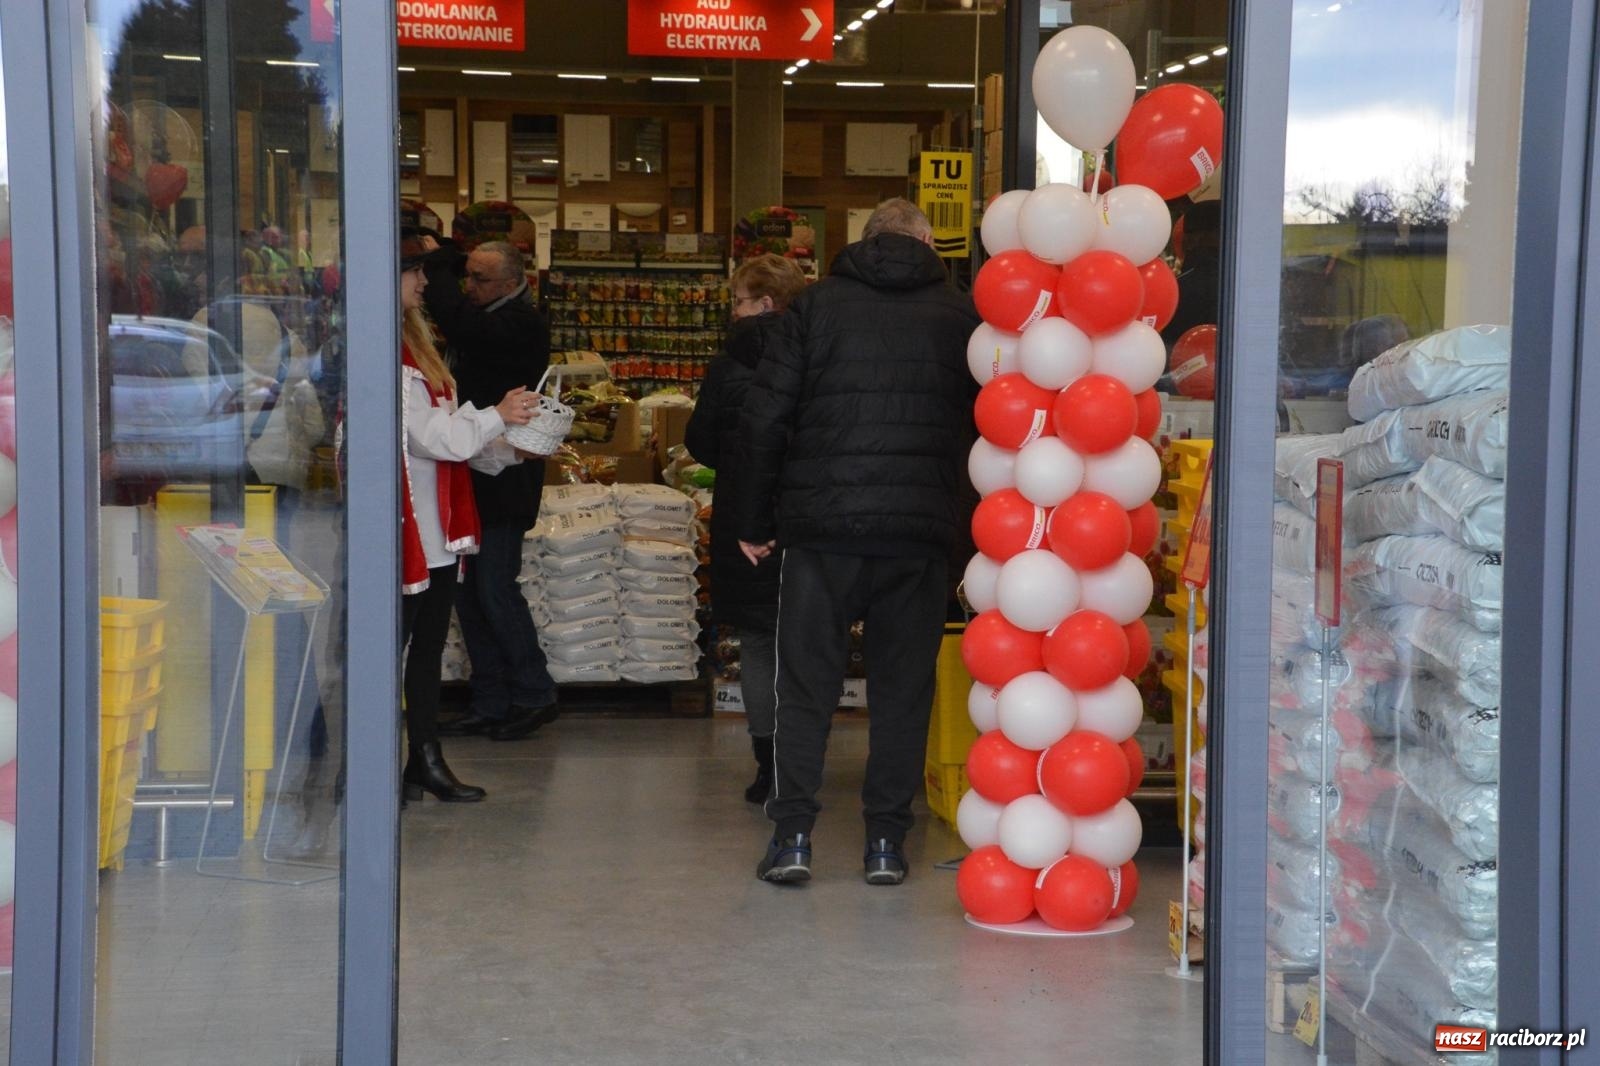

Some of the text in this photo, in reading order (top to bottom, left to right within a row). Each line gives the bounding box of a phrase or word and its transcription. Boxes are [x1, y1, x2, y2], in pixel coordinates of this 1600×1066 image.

[397, 1, 498, 22] DOWLANKA
[697, 0, 731, 10] AGD
[660, 12, 767, 31] HYDRAULIKA
[666, 33, 761, 51] ELEKTRYKA
[930, 159, 962, 180] TU
[923, 182, 968, 190] SPRAWDZISZ
[655, 503, 682, 511] DOLOMIT
